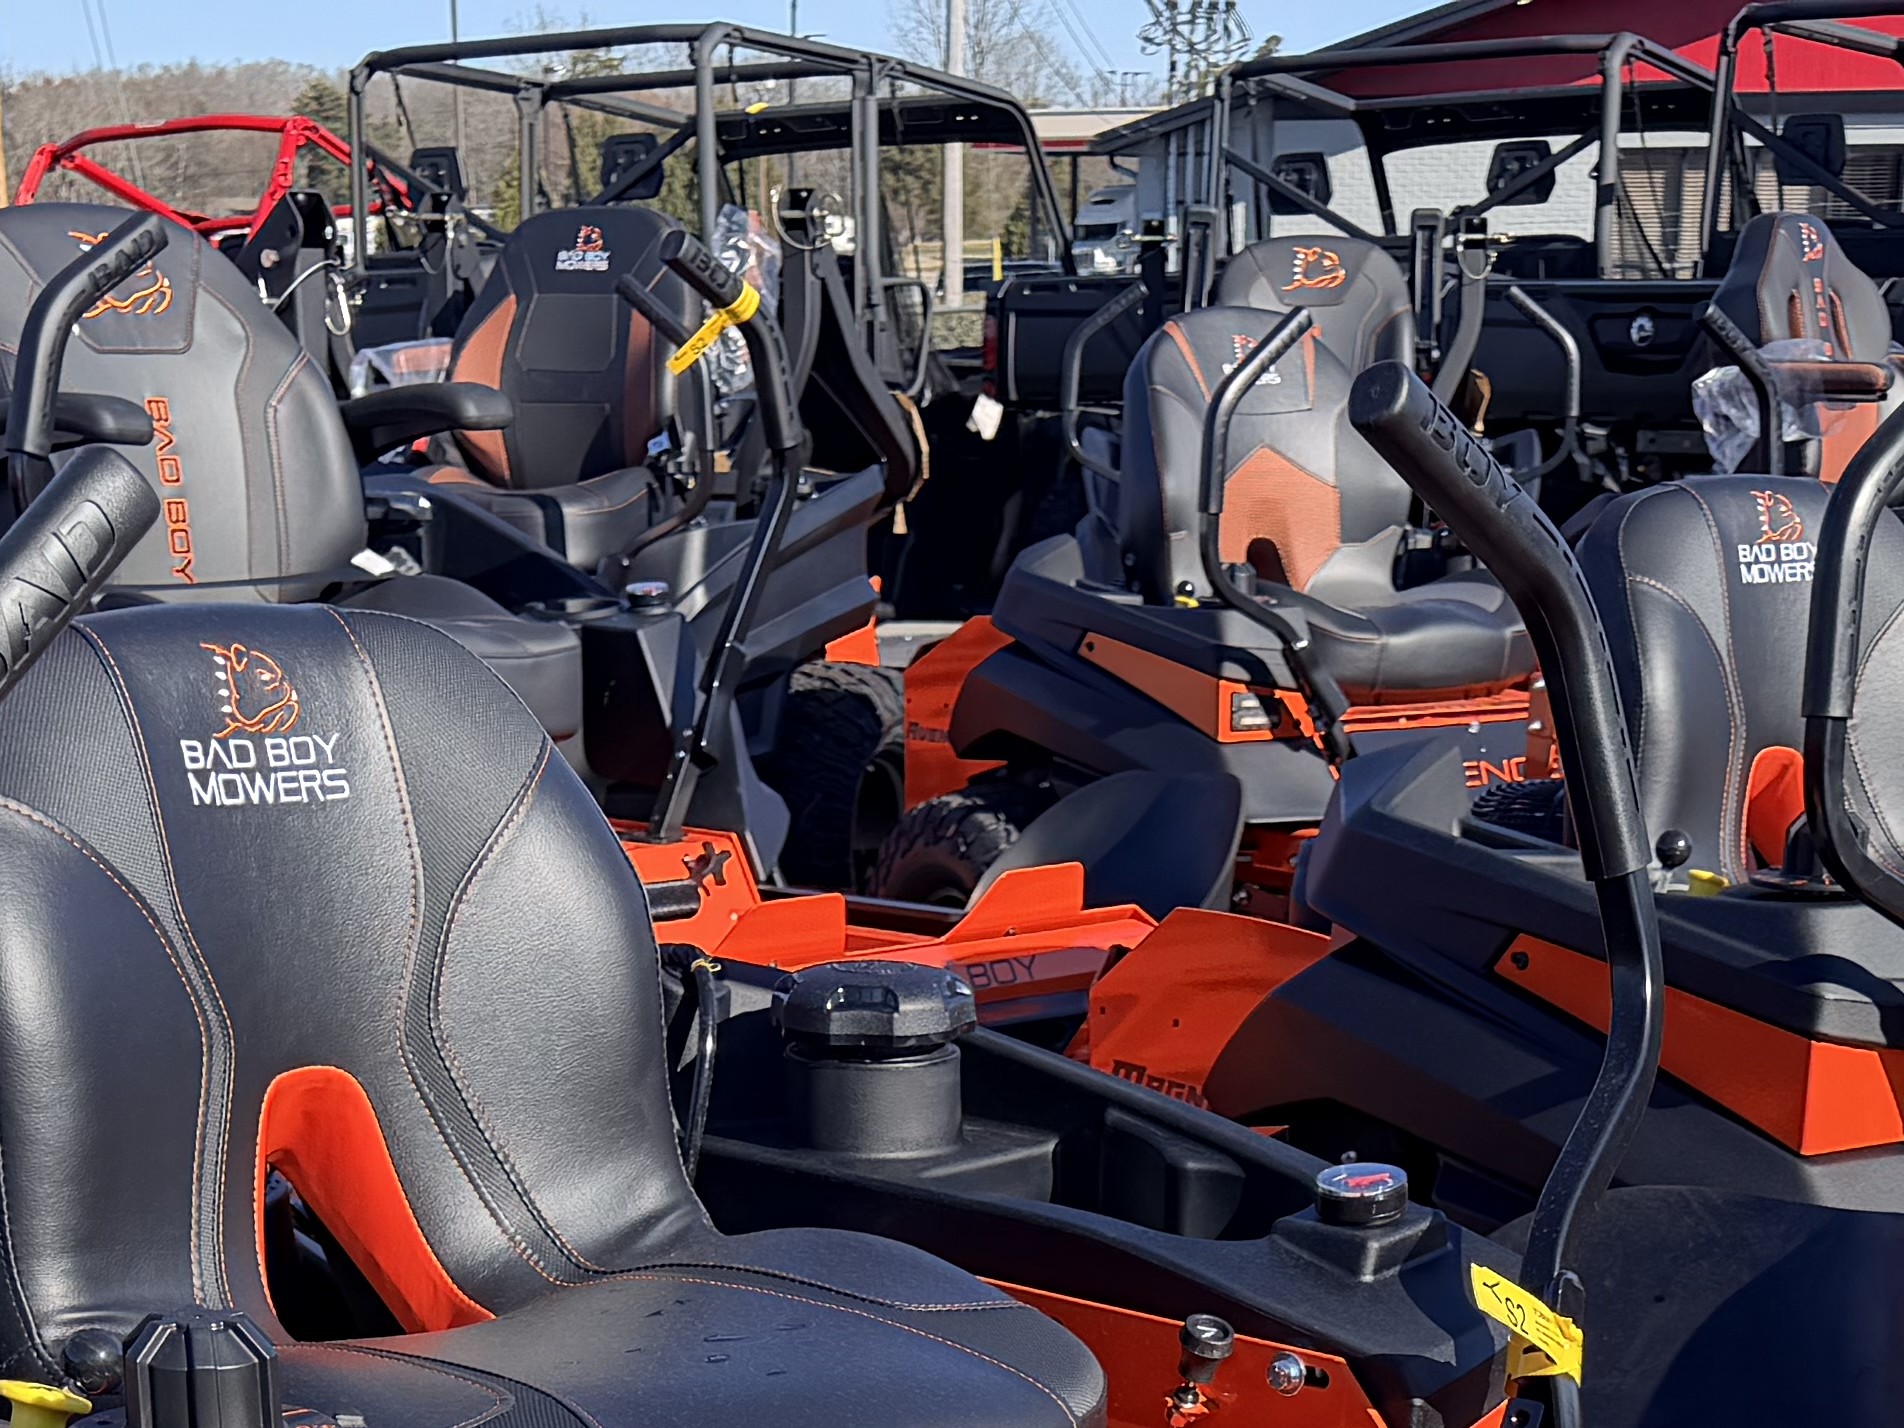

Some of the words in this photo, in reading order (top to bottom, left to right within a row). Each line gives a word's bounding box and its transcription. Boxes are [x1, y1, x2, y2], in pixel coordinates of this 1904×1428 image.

[144, 396, 183, 487] BAD
[163, 497, 197, 584] BOY
[1737, 544, 1776, 562] BAD
[1779, 541, 1818, 561] BOY
[180, 738, 258, 771] BAD
[265, 732, 341, 767] BOY
[188, 767, 351, 807] MOWERS
[966, 953, 1038, 989] BOY
